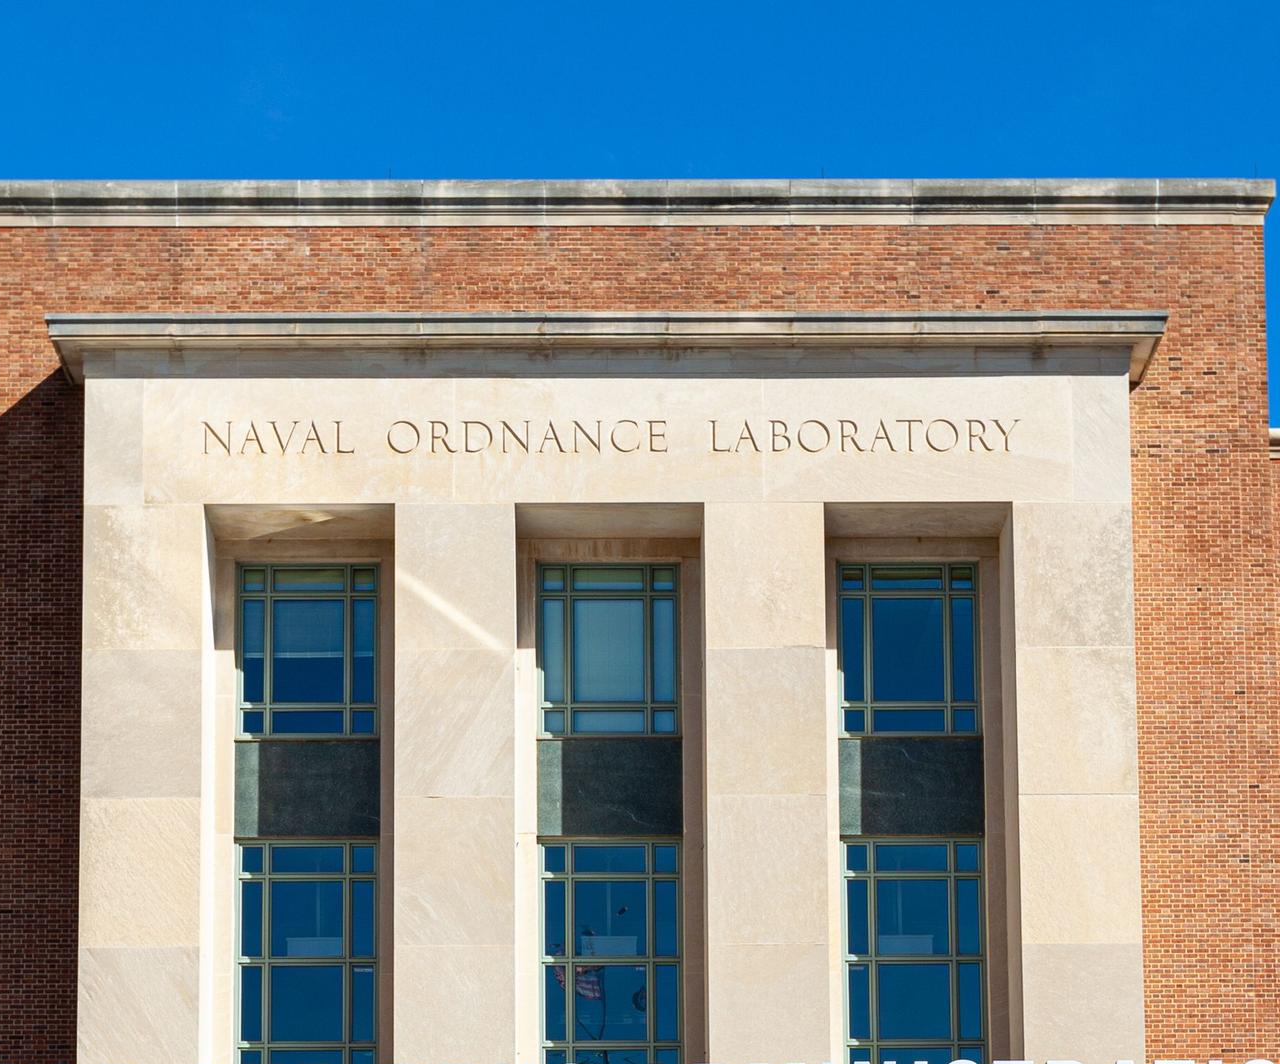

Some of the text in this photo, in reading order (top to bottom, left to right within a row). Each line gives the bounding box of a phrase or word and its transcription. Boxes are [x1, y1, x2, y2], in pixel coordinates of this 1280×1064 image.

[201, 418, 1020, 456] NAVAL ORDNANCE LABORATORY
